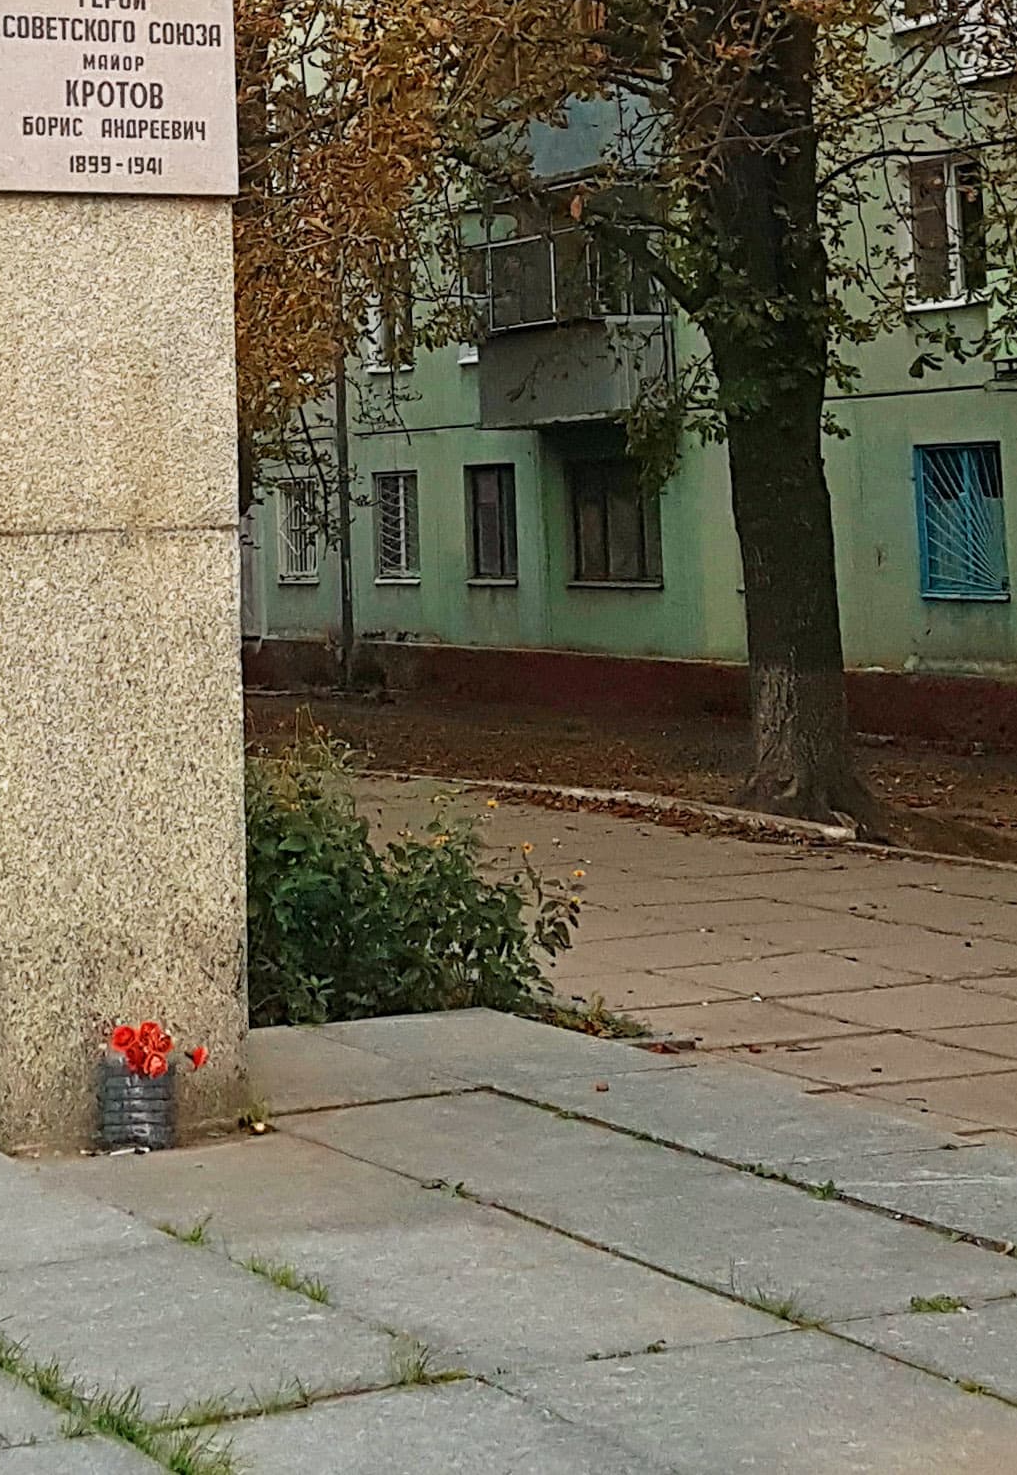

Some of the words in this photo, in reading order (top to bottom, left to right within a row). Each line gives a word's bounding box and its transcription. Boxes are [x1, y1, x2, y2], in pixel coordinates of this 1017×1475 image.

[2, 15, 135, 43] СОВЕТСКОГО
[149, 22, 221, 47] СОЮЗА
[83, 53, 144, 72] МАЙОР
[65, 79, 163, 109] КРОТОВ
[22, 116, 83, 137] БОРИС
[101, 118, 206, 141] АНДРЕЕВИЧ
